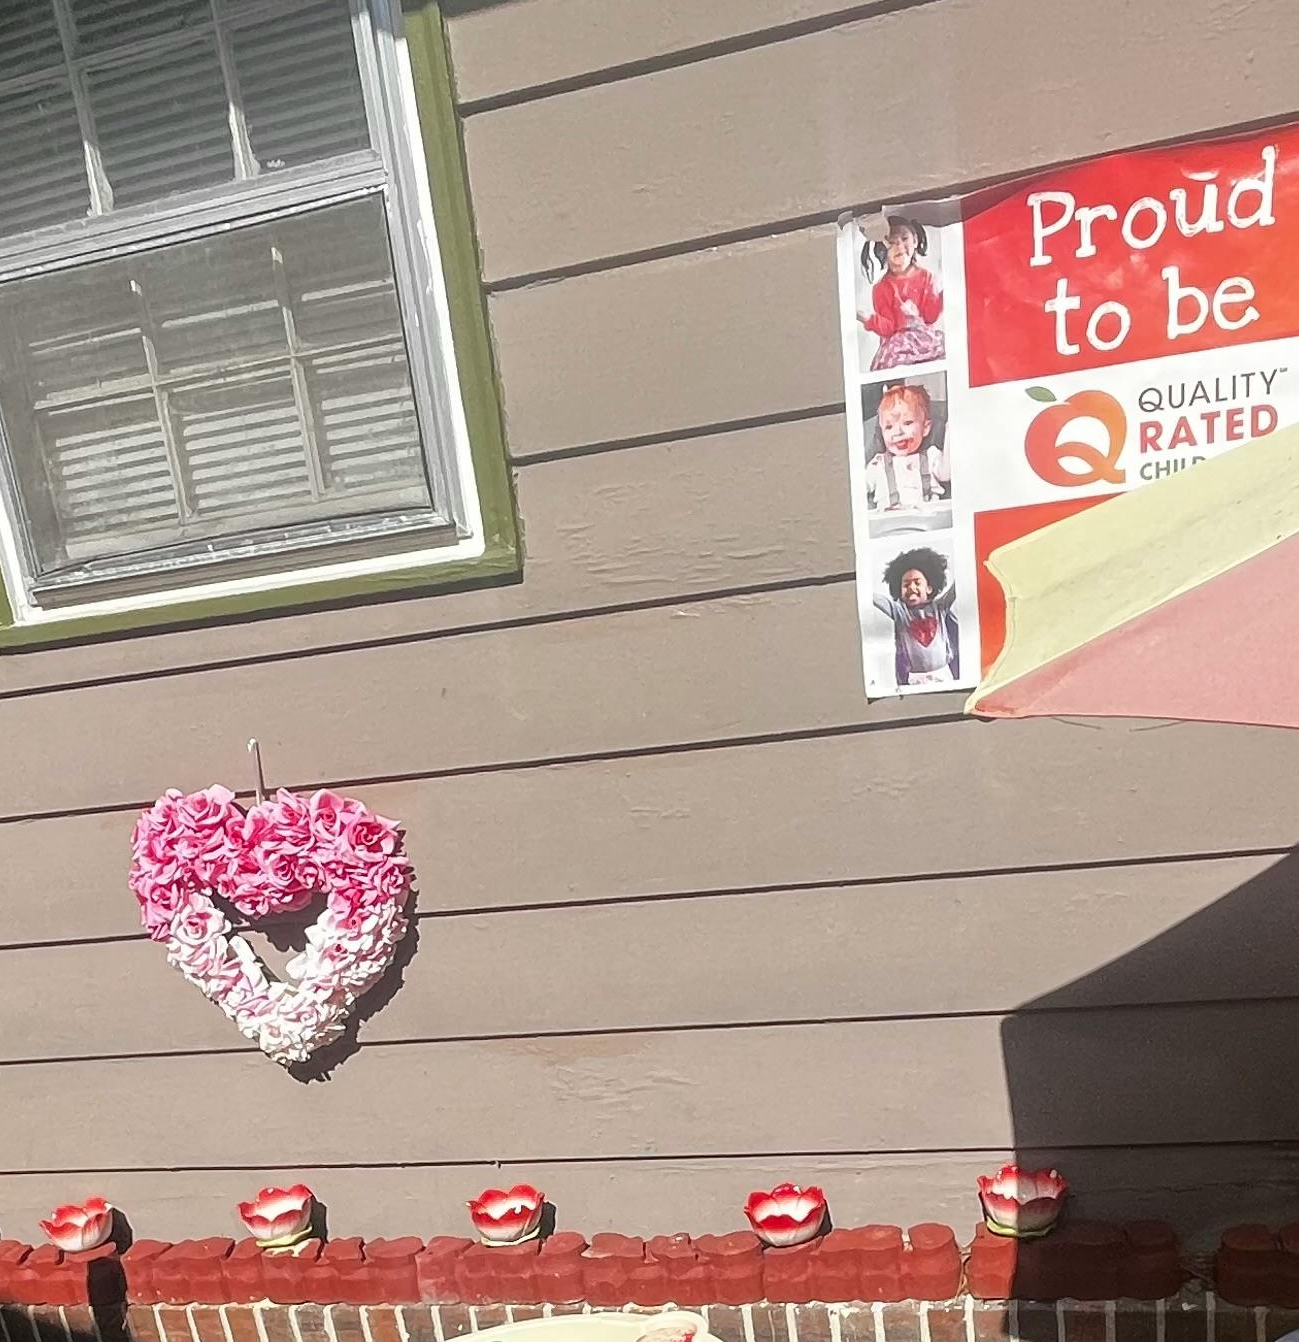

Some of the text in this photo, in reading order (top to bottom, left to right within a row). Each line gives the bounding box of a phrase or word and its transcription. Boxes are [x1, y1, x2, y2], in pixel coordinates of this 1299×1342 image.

[1026, 144, 1277, 267] Proud
[1044, 265, 1261, 356] to be
[1139, 403, 1279, 454] RATED
[1139, 455, 1207, 481] CHI
